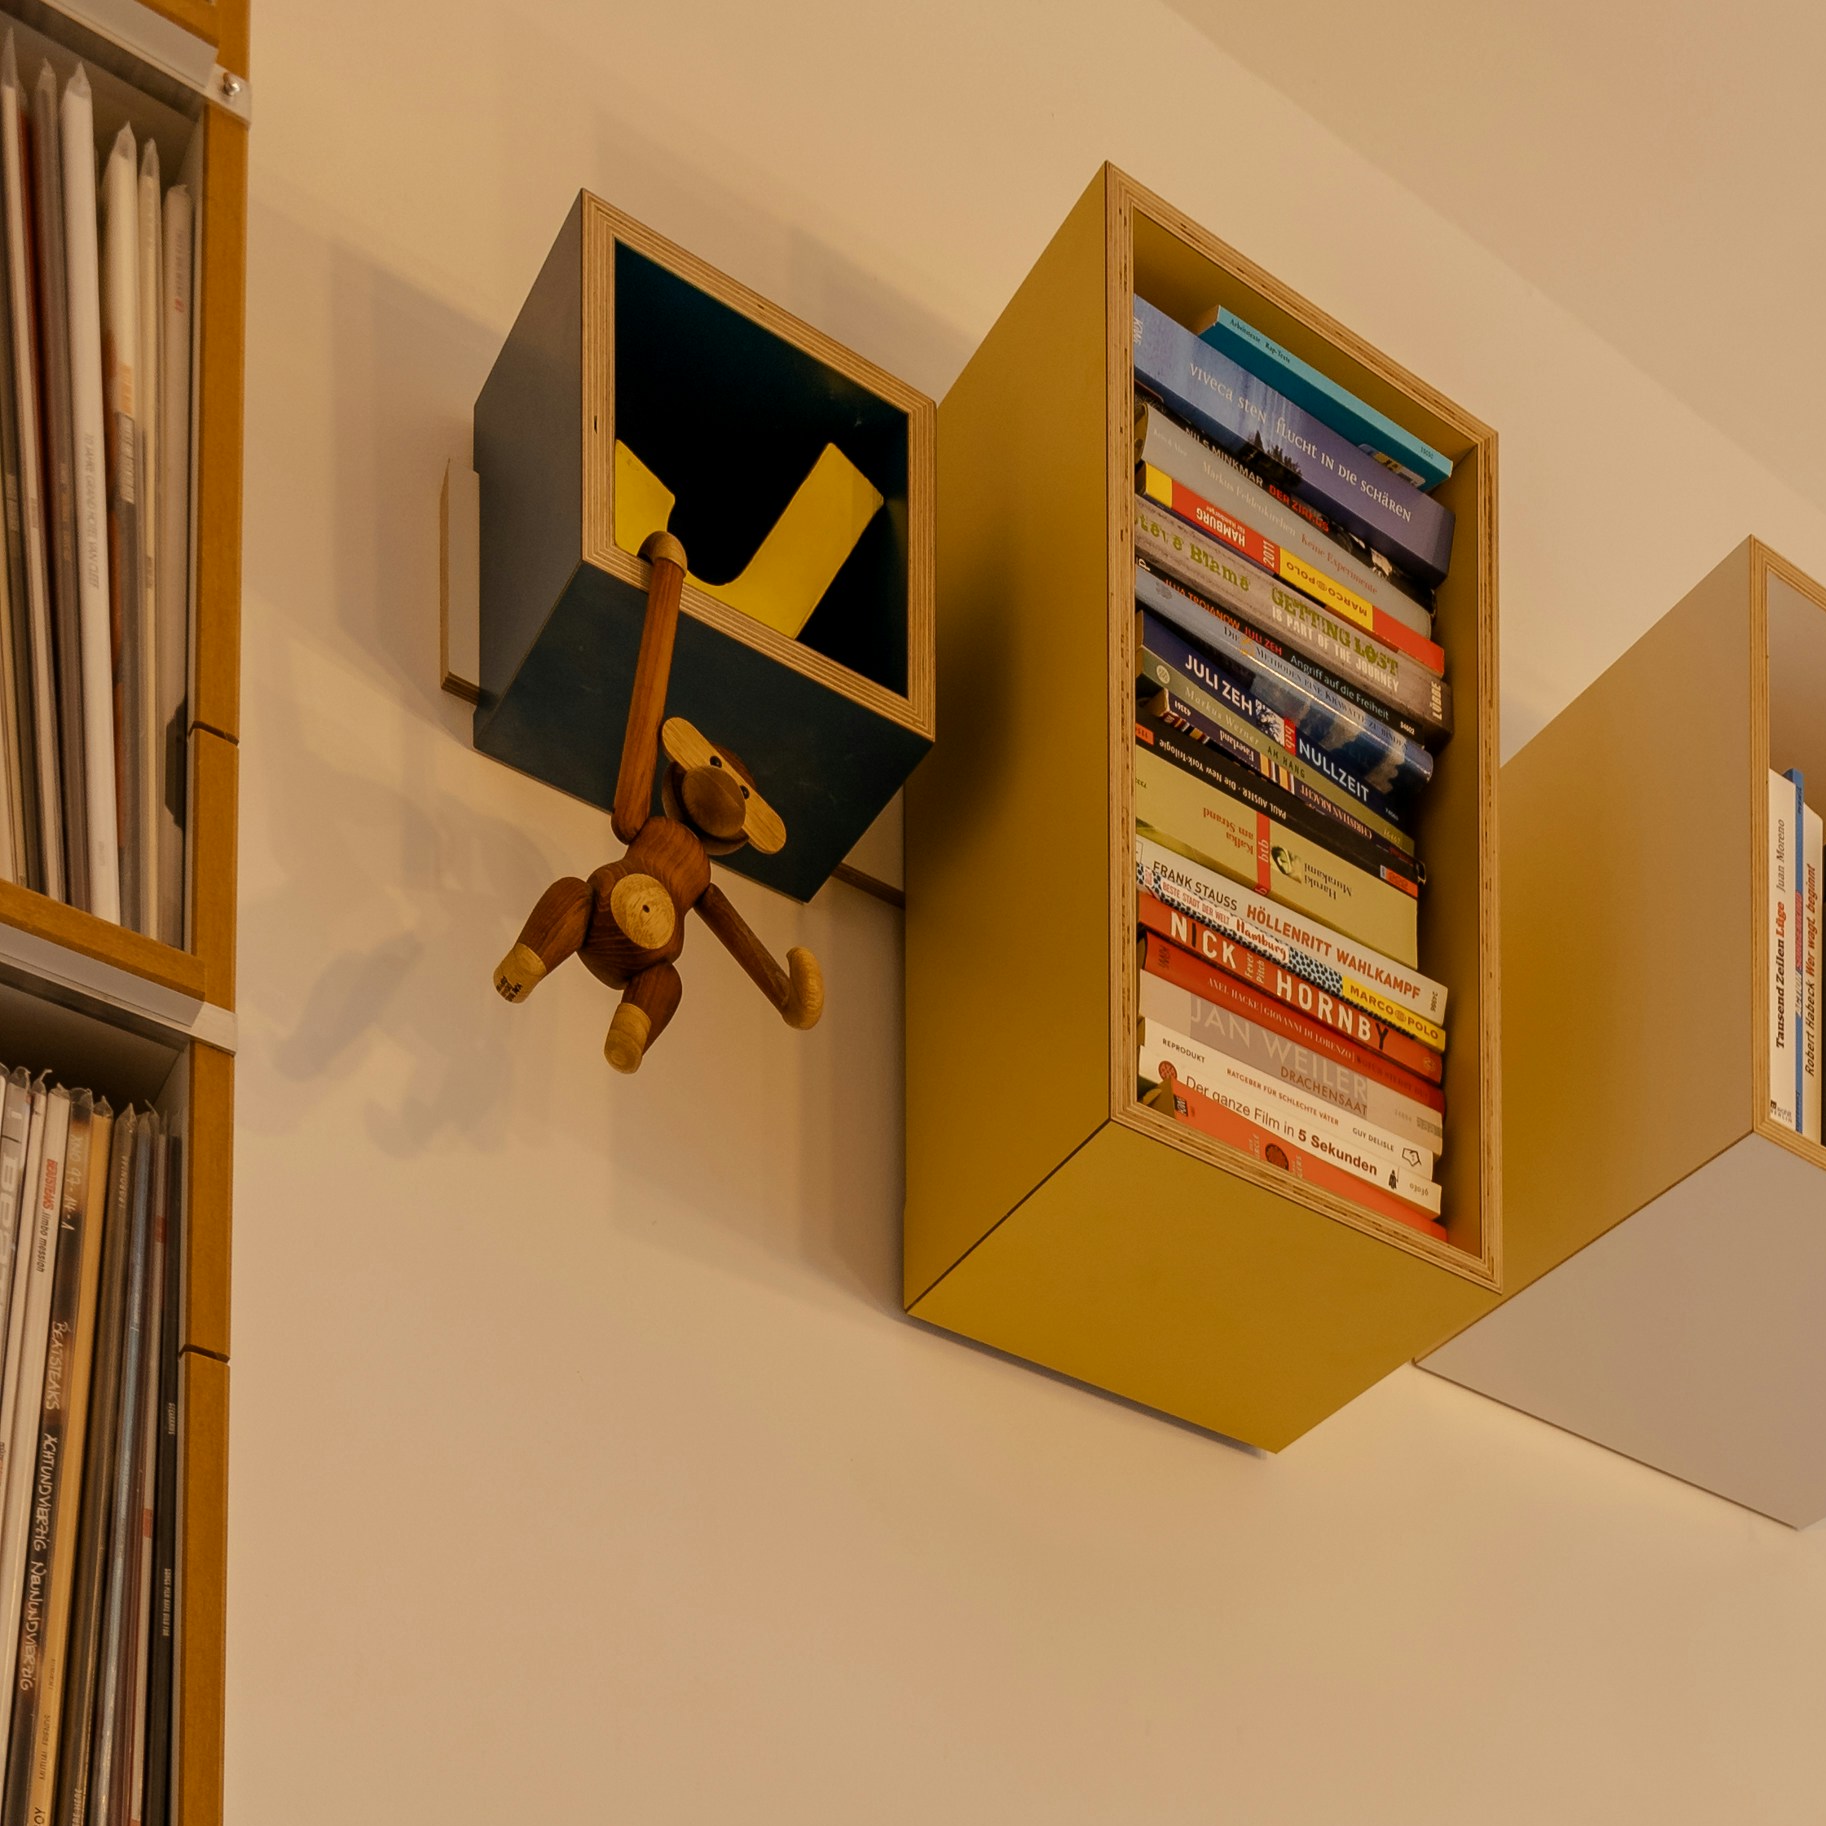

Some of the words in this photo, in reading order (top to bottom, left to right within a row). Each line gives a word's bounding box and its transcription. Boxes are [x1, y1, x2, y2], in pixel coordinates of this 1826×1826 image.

[86, 474, 97, 508] GRAND
[1212, 445, 1264, 487] MINKMAR
[1269, 484, 1290, 505] DER
[87, 509, 97, 538] HOTEL
[1196, 507, 1246, 547] HAMBURG
[88, 540, 98, 560] VAN
[1262, 541, 1276, 568] 2011
[89, 561, 99, 590] CLEEF
[1287, 562, 1317, 586] POLO
[1326, 547, 1378, 595] Experimente
[1271, 586, 1352, 646] GETTING
[1328, 586, 1367, 617] MARCO
[1264, 638, 1283, 656] ZEH
[1286, 615, 1315, 640] PART
[1317, 633, 1331, 646] OF
[1334, 641, 1352, 662] THE
[1355, 652, 1400, 693] JOURNEY
[1185, 658, 1218, 690] JULI
[1222, 680, 1253, 715] ZEH
[1290, 653, 1321, 682] Angriff
[1323, 676, 1338, 691] auf
[1340, 684, 1354, 699] die
[1355, 691, 1389, 720] Freiheit
[1185, 686, 1221, 717] Markus
[1223, 708, 1259, 746] Werner
[1219, 730, 1255, 760] Faserland
[1267, 746, 1280, 759] AM
[1282, 755, 1305, 779] HANG
[1206, 771, 1221, 788] New
[1299, 738, 1369, 802] NULLZEIT
[1242, 790, 1268, 812] AUSTER
[1270, 803, 1287, 819] PAUL
[1300, 784, 1333, 813] KRACHT
[1203, 807, 1235, 834] Strand
[1237, 825, 1254, 840] am
[1334, 805, 1372, 840] CHRISTIAN
[1226, 832, 1254, 855] Kafka
[1258, 840, 1268, 863] btb
[1775, 819, 1786, 864] Moreno
[1304, 862, 1352, 897] Murakami
[1304, 875, 1337, 899] Haruki
[1776, 867, 1787, 893] Juan
[1806, 864, 1815, 914] beginnt
[1163, 882, 1180, 901] BESTE
[1182, 891, 1201, 910] STADT
[1203, 902, 1214, 916] DER
[1215, 908, 1230, 924] WELT
[1775, 902, 1787, 938] Lüge
[1153, 861, 1192, 889] FRANK
[1194, 881, 1237, 911] STAUSS
[1247, 905, 1333, 956] HÖLLENRITT
[1336, 949, 1421, 999] WAHLKAMPF
[1236, 920, 1289, 962] Hamburg
[1170, 912, 1238, 969] NICK
[1276, 971, 1389, 1050] HORNBY
[1244, 953, 1254, 979] Fever
[1255, 959, 1266, 984] Pitch
[1775, 941, 1787, 986] Zeilen
[1805, 953, 1815, 979] Wer
[1208, 977, 1230, 993] AXEL
[1231, 988, 1259, 1010] HACKE
[1264, 1003, 1302, 1032] GIOVANNI
[1315, 1029, 1352, 1060] LORENZO
[1349, 985, 1394, 1017] MARCO
[1407, 1015, 1439, 1040] POLO
[1775, 987, 1787, 1050] Tausend
[1805, 982, 1815, 1029] Habeck
[1162, 1038, 1205, 1064] REPRODUKT
[1191, 996, 1251, 1049] JAN
[1260, 1031, 1368, 1100] WEILER
[1804, 1031, 1815, 1077] Robert
[1227, 1068, 1262, 1090] RATGEBER
[1263, 1085, 1278, 1098] FÜR
[1279, 1092, 1317, 1116] SCHLECHTE
[1318, 1107, 1339, 1127] VÄTER
[1279, 1065, 1368, 1116] DRACHENSAAT
[1186, 1075, 1209, 1099] Der
[1212, 1090, 1251, 1117] ganze
[1254, 1107, 1280, 1131] Film
[1284, 1120, 1295, 1136] in
[1298, 1128, 1307, 1142] 5
[1310, 1133, 1377, 1176] Sekunden
[1352, 1127, 1366, 1140] GUY
[1368, 1132, 1395, 1152] DELISLE
[40, 1212, 52, 1238] limbo
